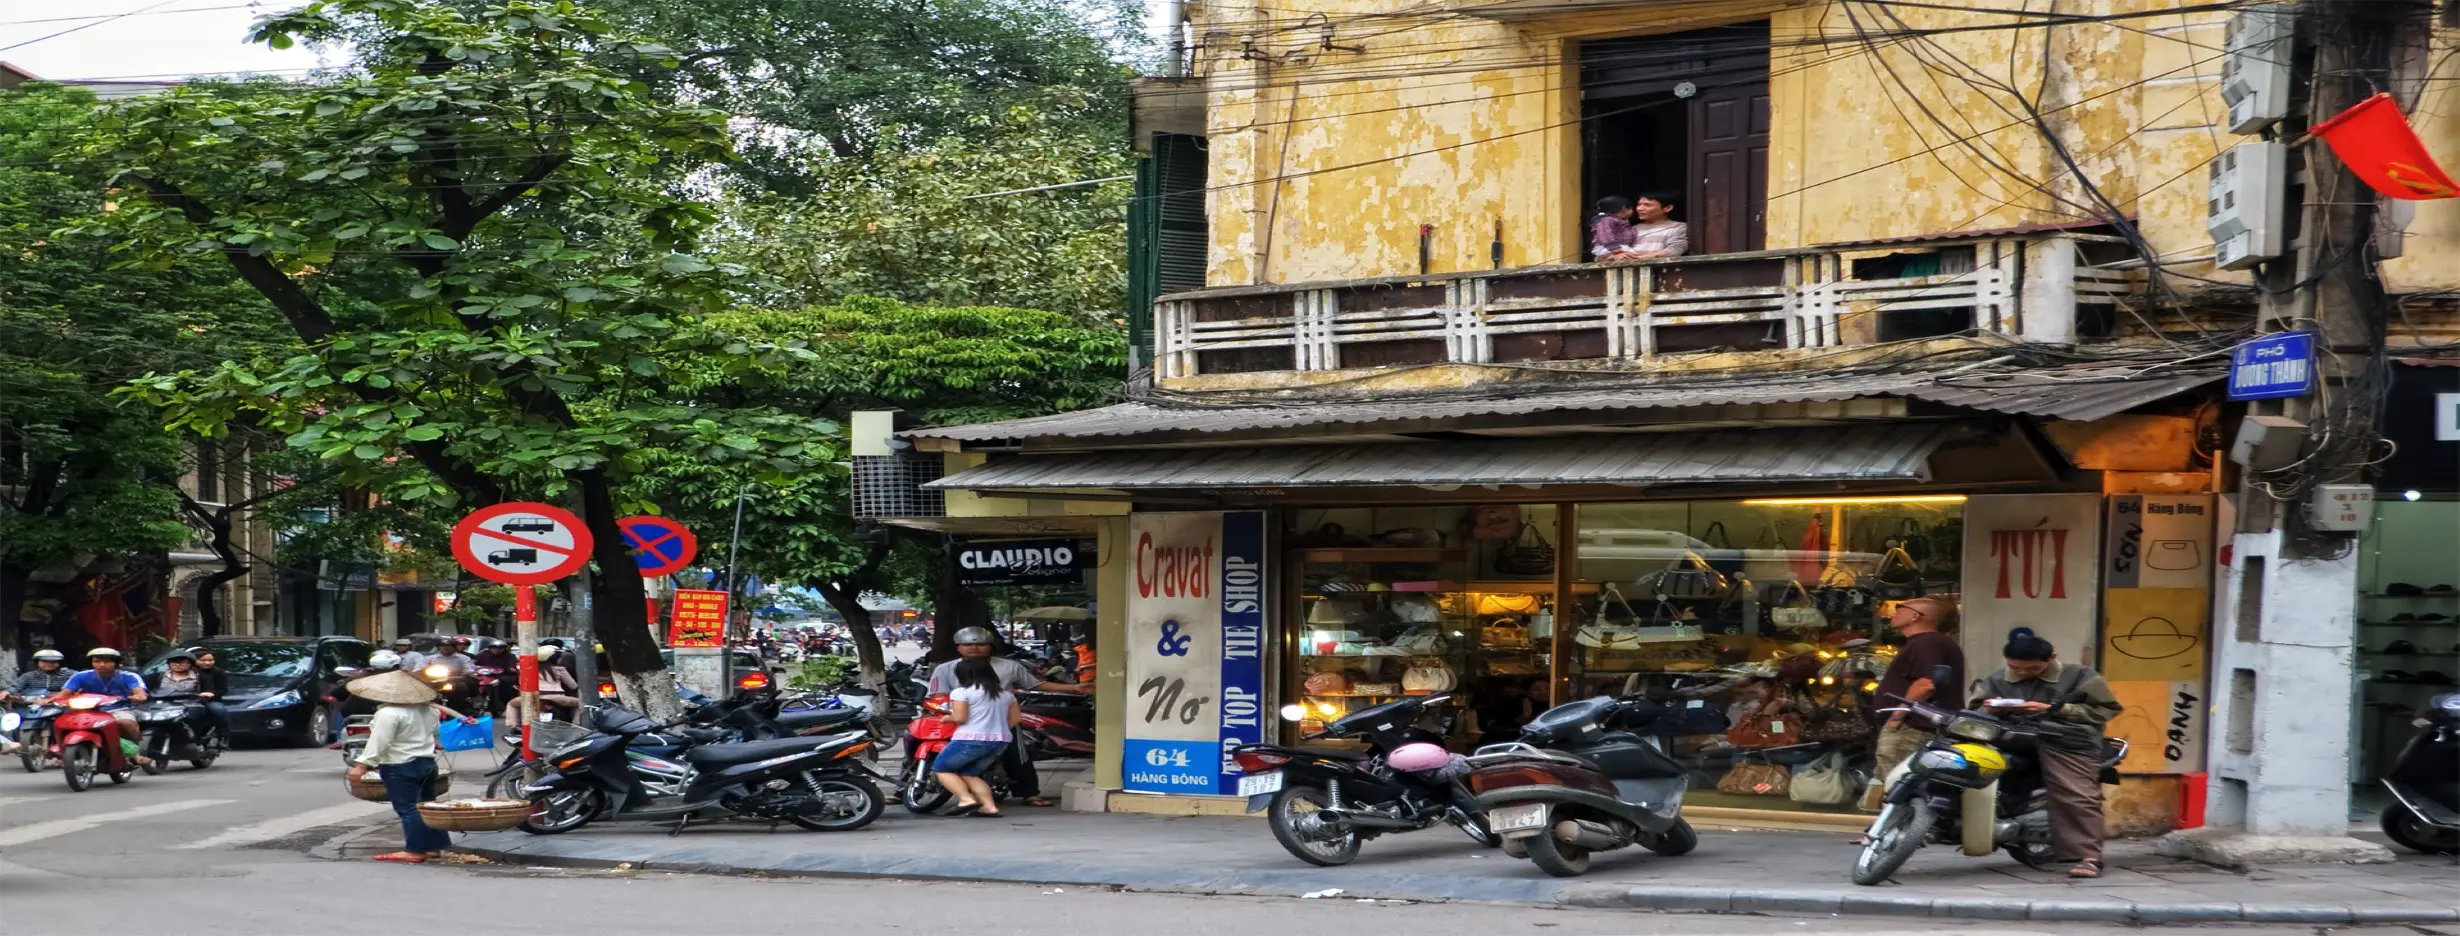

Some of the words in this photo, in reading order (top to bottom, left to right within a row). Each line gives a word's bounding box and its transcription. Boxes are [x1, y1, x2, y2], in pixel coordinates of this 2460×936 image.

[959, 546, 1073, 569] CLAUDIO
[1136, 531, 1214, 599] Cravat
[1990, 515, 2069, 600] TÚI
[1223, 556, 1260, 614] SHOP
[1157, 619, 1191, 657] &
[1223, 625, 1260, 661] TIE
[1138, 675, 1209, 725] Nơ
[1222, 686, 1258, 729] TOP
[1145, 748, 1192, 767] 64
[1131, 770, 1168, 784] HÀNG
[1171, 771, 1209, 786] BÔNG
